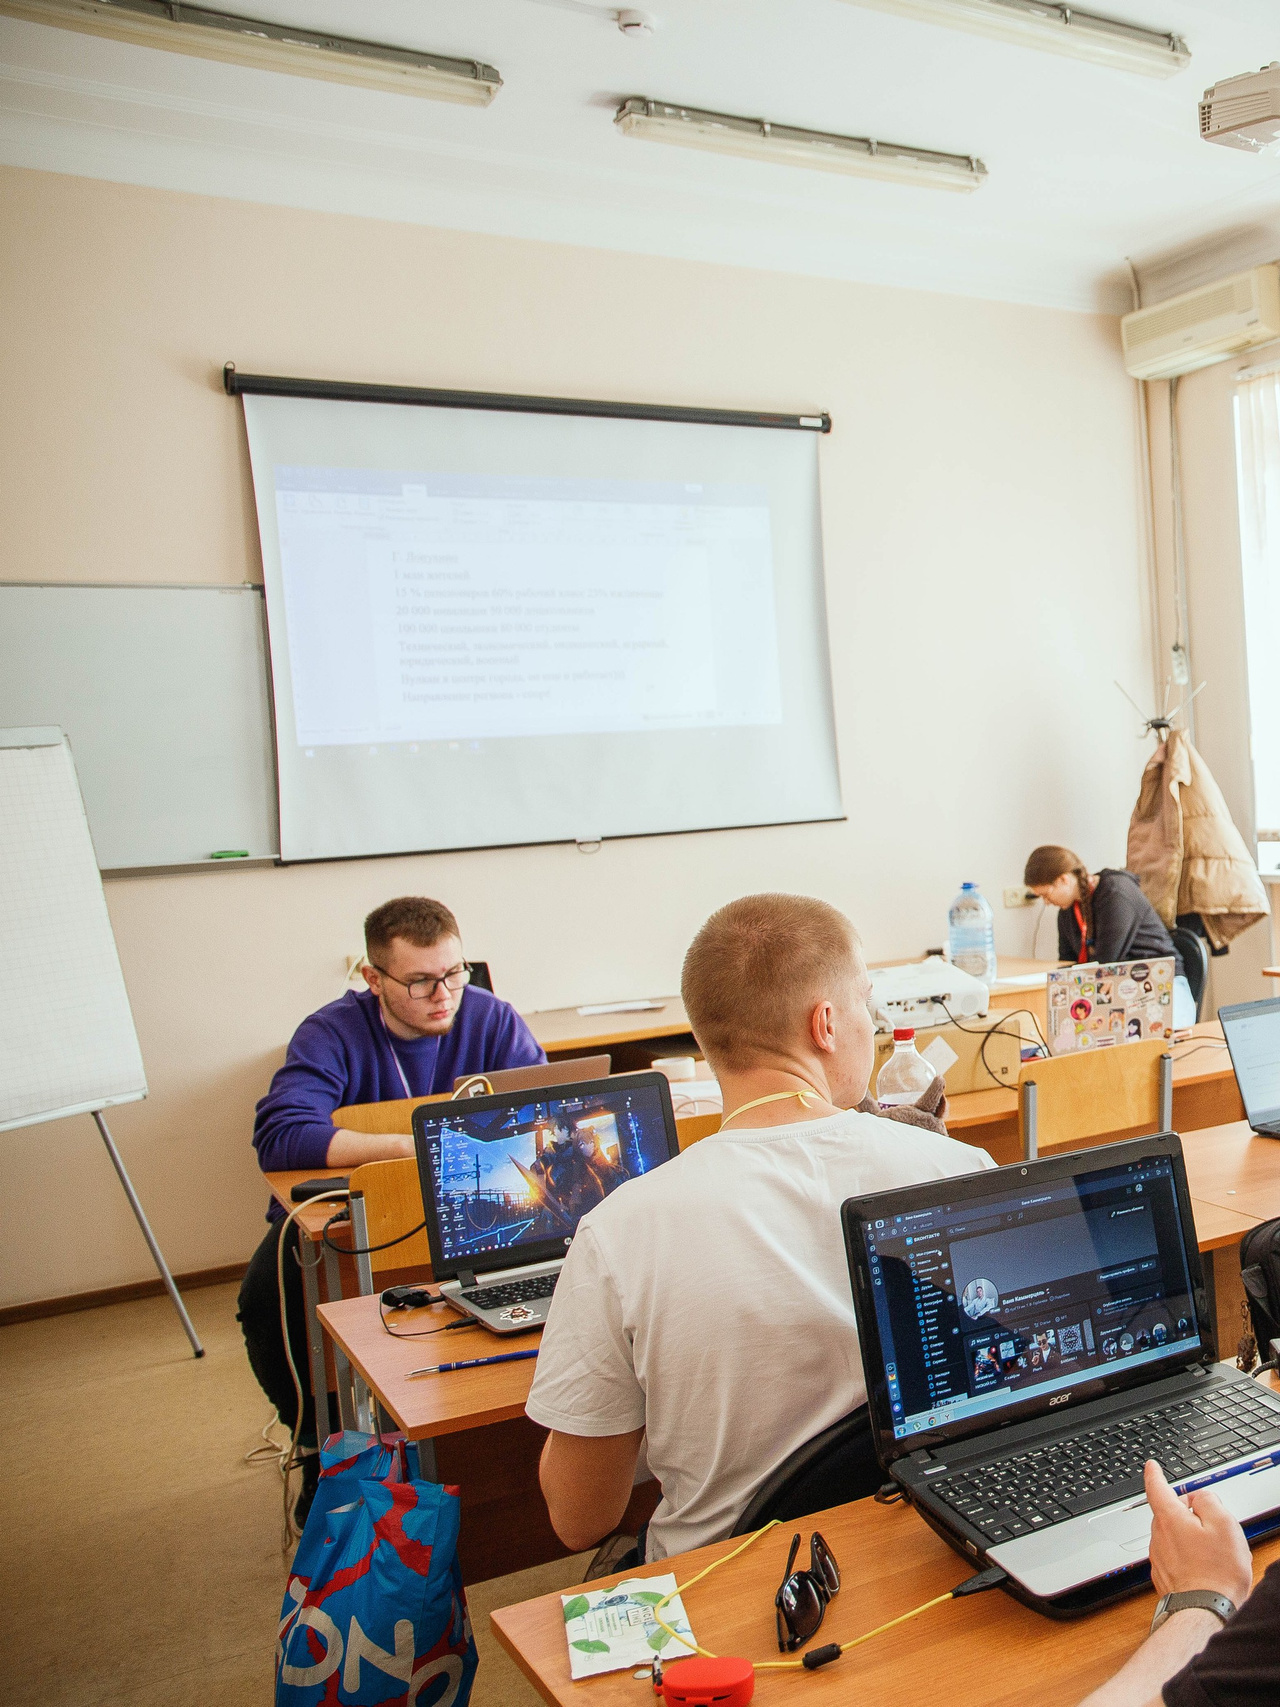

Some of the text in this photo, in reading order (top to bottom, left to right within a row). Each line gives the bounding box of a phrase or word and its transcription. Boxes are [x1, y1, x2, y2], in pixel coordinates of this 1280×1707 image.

[427, 570, 470, 580] жителей
[515, 587, 555, 599] рабочий
[411, 605, 431, 615] 000
[398, 623, 416, 633] 100
[418, 623, 437, 633] 000
[1049, 1392, 1072, 1406] acer
